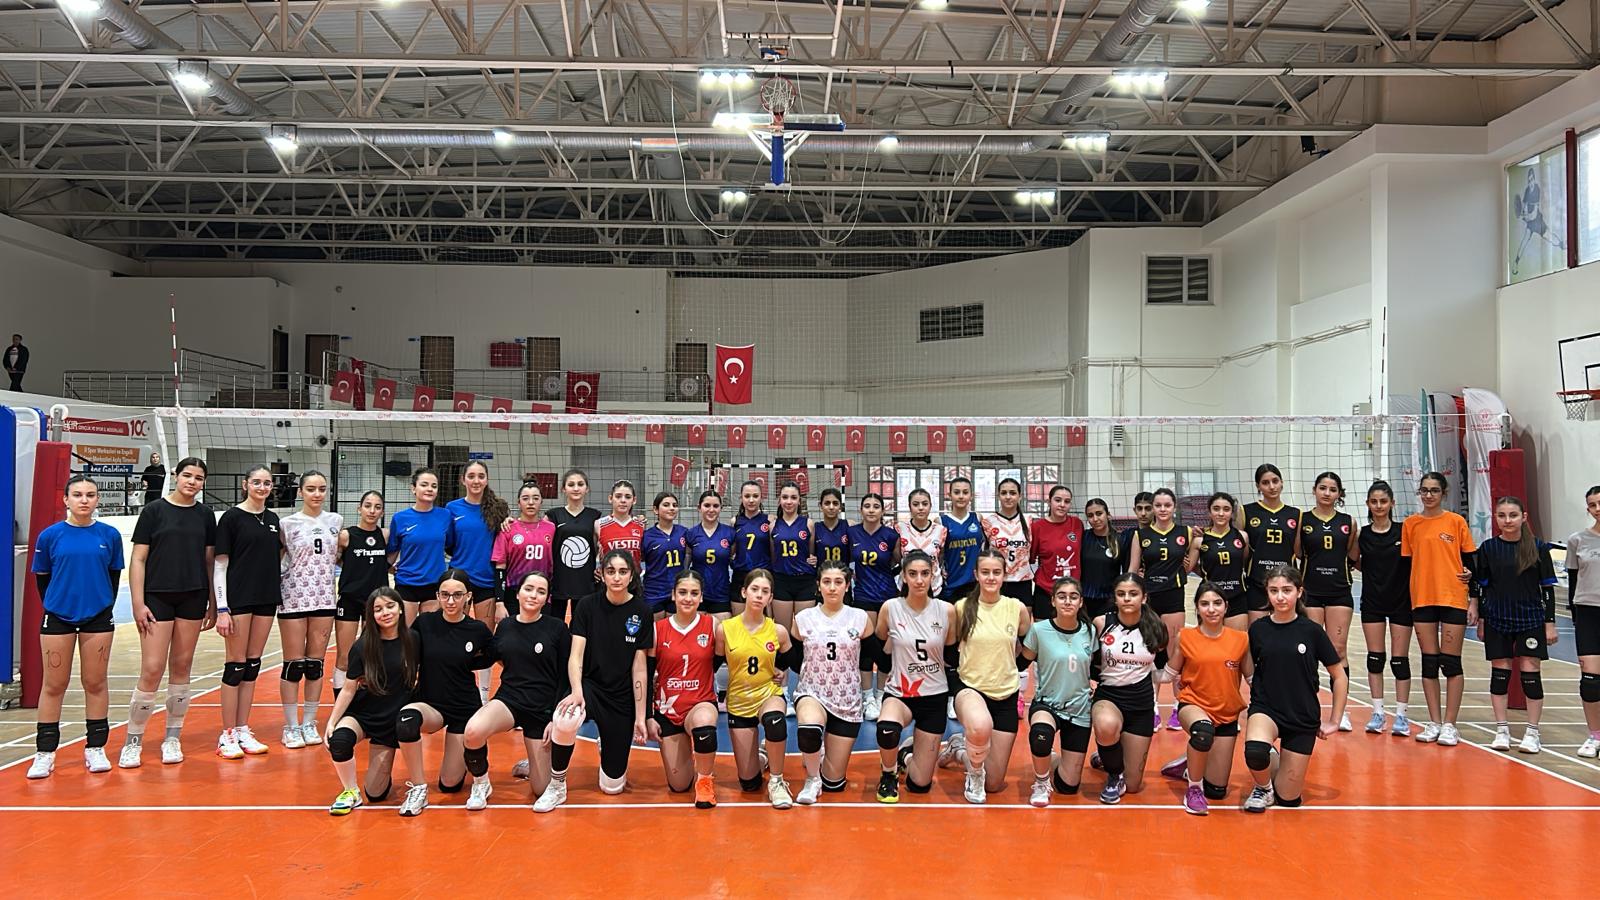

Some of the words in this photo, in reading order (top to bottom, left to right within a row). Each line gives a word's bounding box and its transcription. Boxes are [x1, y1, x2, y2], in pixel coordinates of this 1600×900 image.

[746, 533, 756, 550] 7
[1266, 529, 1282, 544] 53
[1324, 535, 1332, 549] 8
[314, 538, 322, 554] 9
[525, 544, 544, 560] 80
[781, 540, 798, 557] 13
[824, 547, 841, 560] 18
[1160, 548, 1168, 560] 3
[666, 550, 681, 567] 11
[706, 549, 716, 564] 5
[861, 550, 878, 566] 12
[1008, 551, 1015, 562] 5
[1218, 551, 1230, 565] 19
[827, 642, 836, 661] 3
[915, 639, 928, 661] 5
[1122, 642, 1135, 654] 21
[46, 650, 61, 668] 10
[682, 654, 689, 677] 1
[748, 656, 759, 675] 8
[1068, 654, 1077, 672] 6
[635, 680, 642, 701] 9
